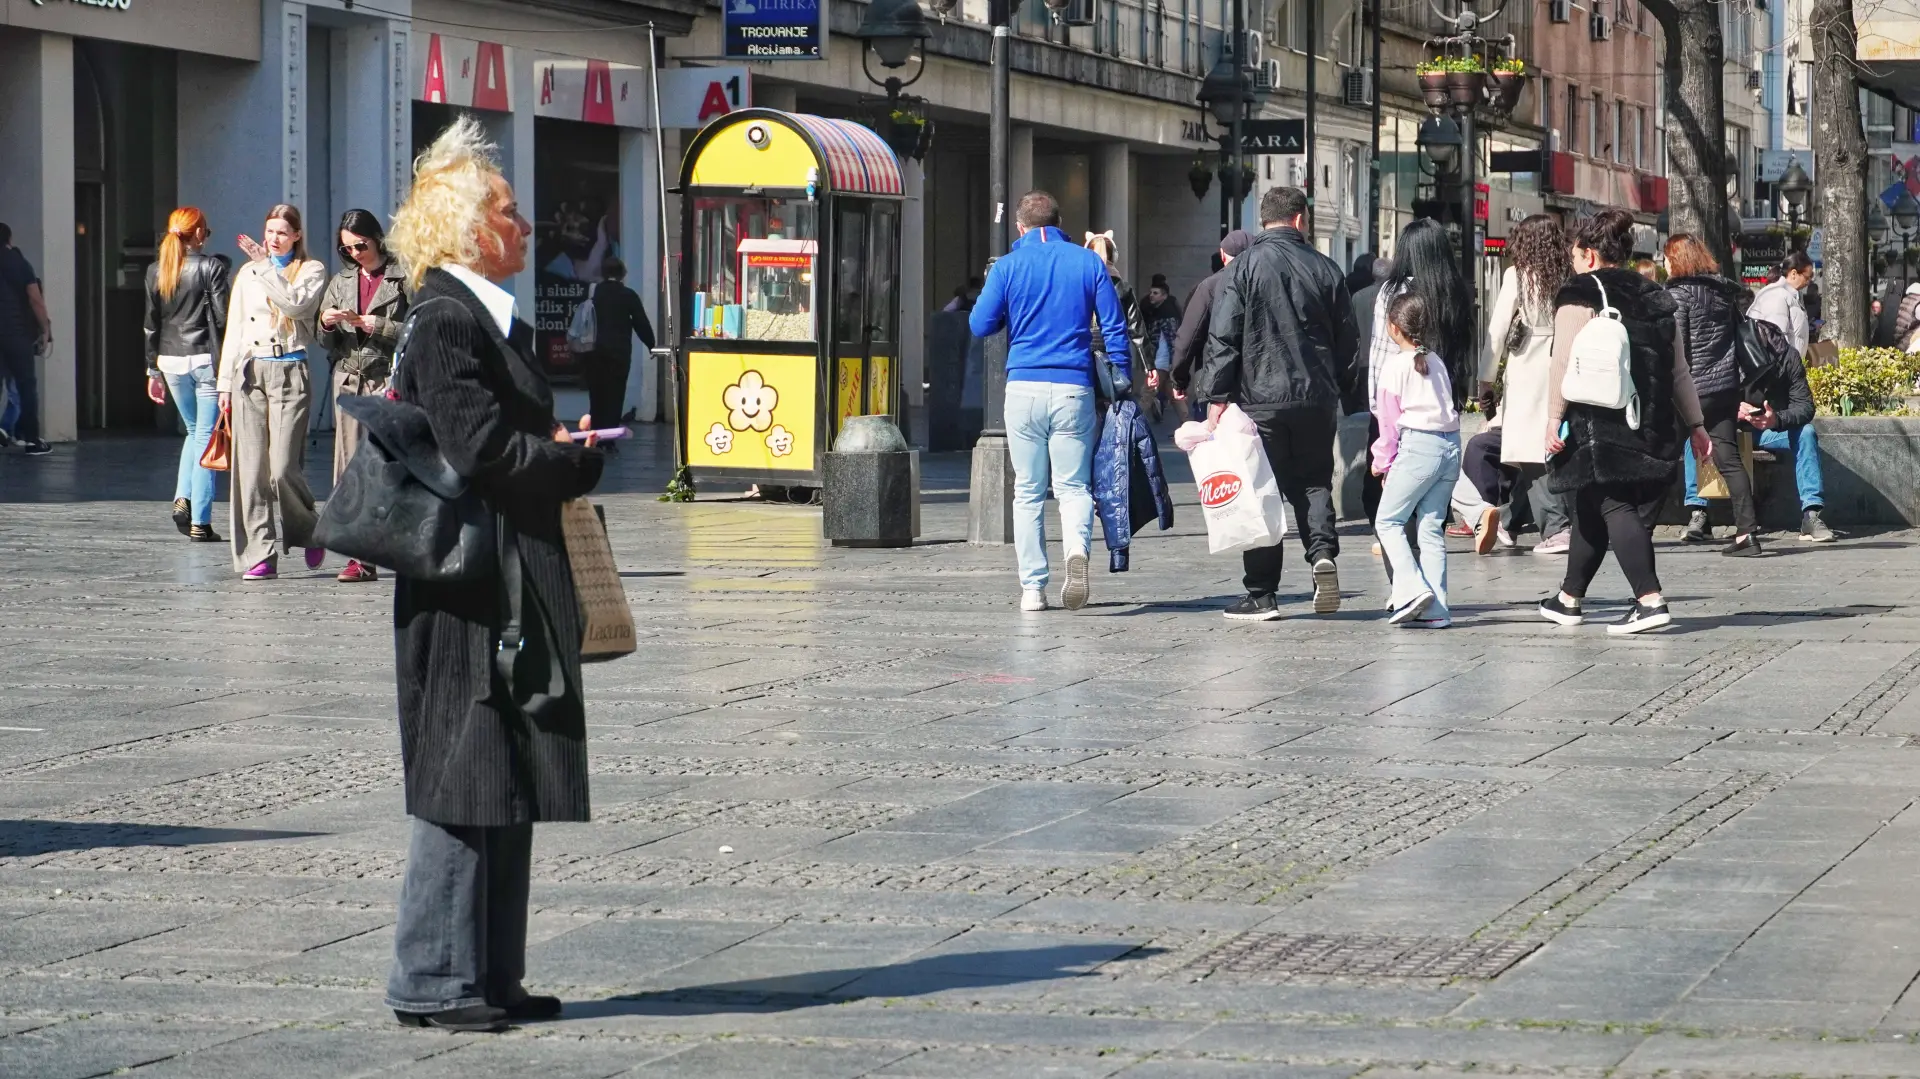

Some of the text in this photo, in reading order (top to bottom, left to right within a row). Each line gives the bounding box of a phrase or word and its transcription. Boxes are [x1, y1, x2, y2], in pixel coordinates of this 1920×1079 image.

[758, 0, 817, 10] ILIRIKA
[740, 26, 809, 38] TRGOVANJE
[698, 75, 740, 120] A1
[1240, 134, 1300, 147] ZARA
[1199, 480, 1241, 504] Metro
[589, 623, 631, 643] Laguna
